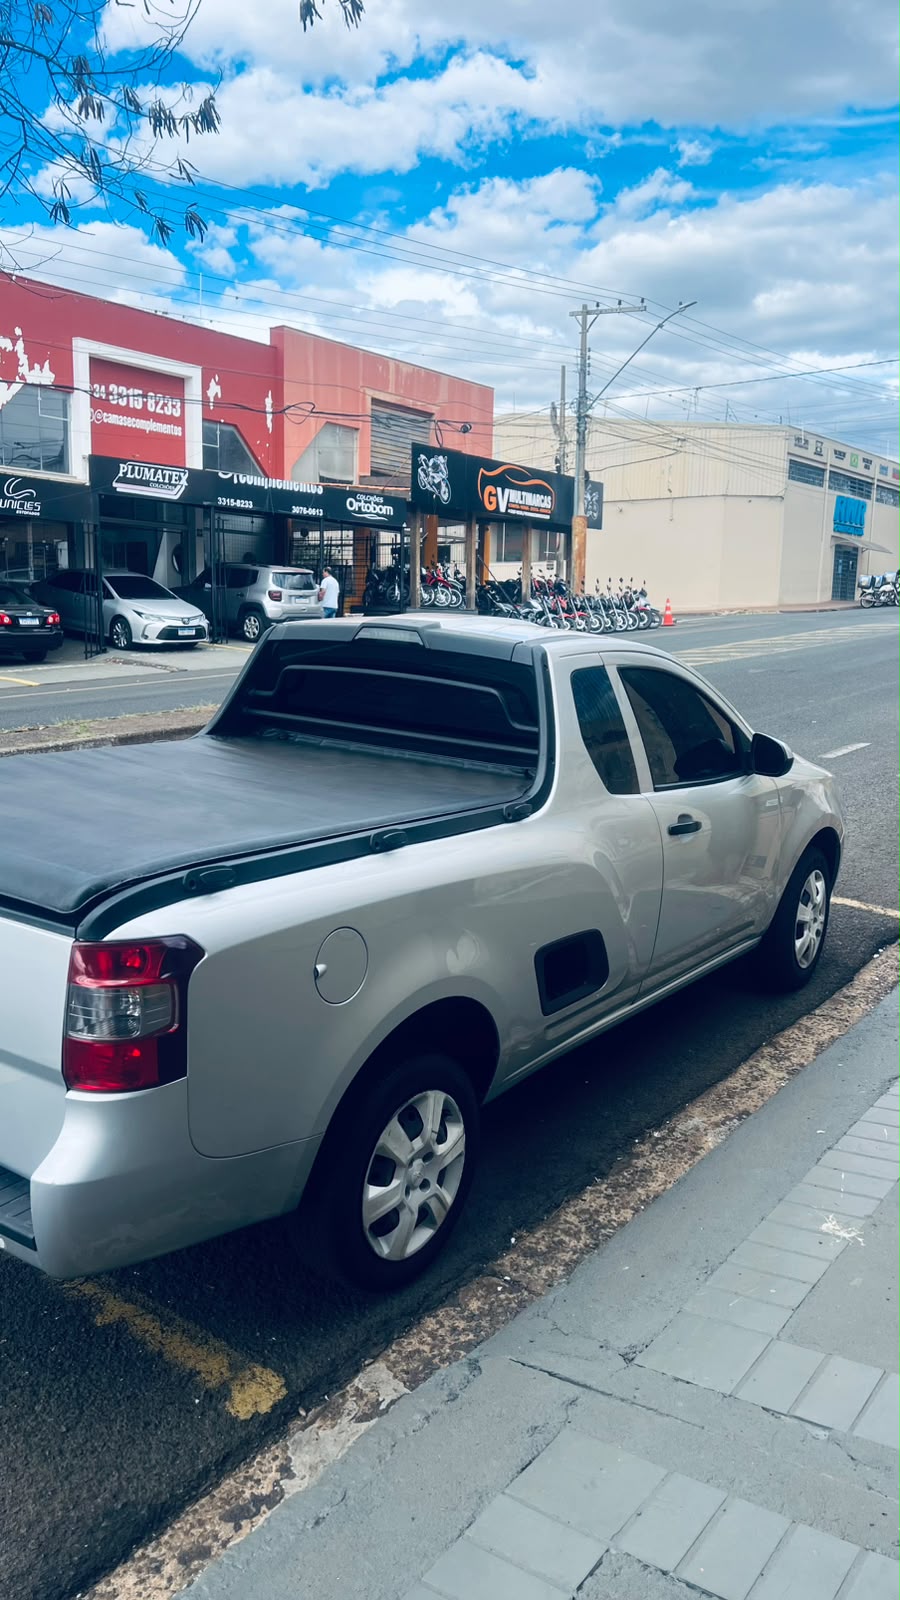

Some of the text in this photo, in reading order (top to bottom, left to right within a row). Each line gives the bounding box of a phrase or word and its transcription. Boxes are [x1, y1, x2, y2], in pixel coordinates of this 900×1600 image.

[119, 464, 188, 486] PLUMATEX
[217, 497, 253, 508] 3315-8233
[346, 498, 394, 516] Ortobom
[509, 489, 552, 509] MULTIMARCAS
